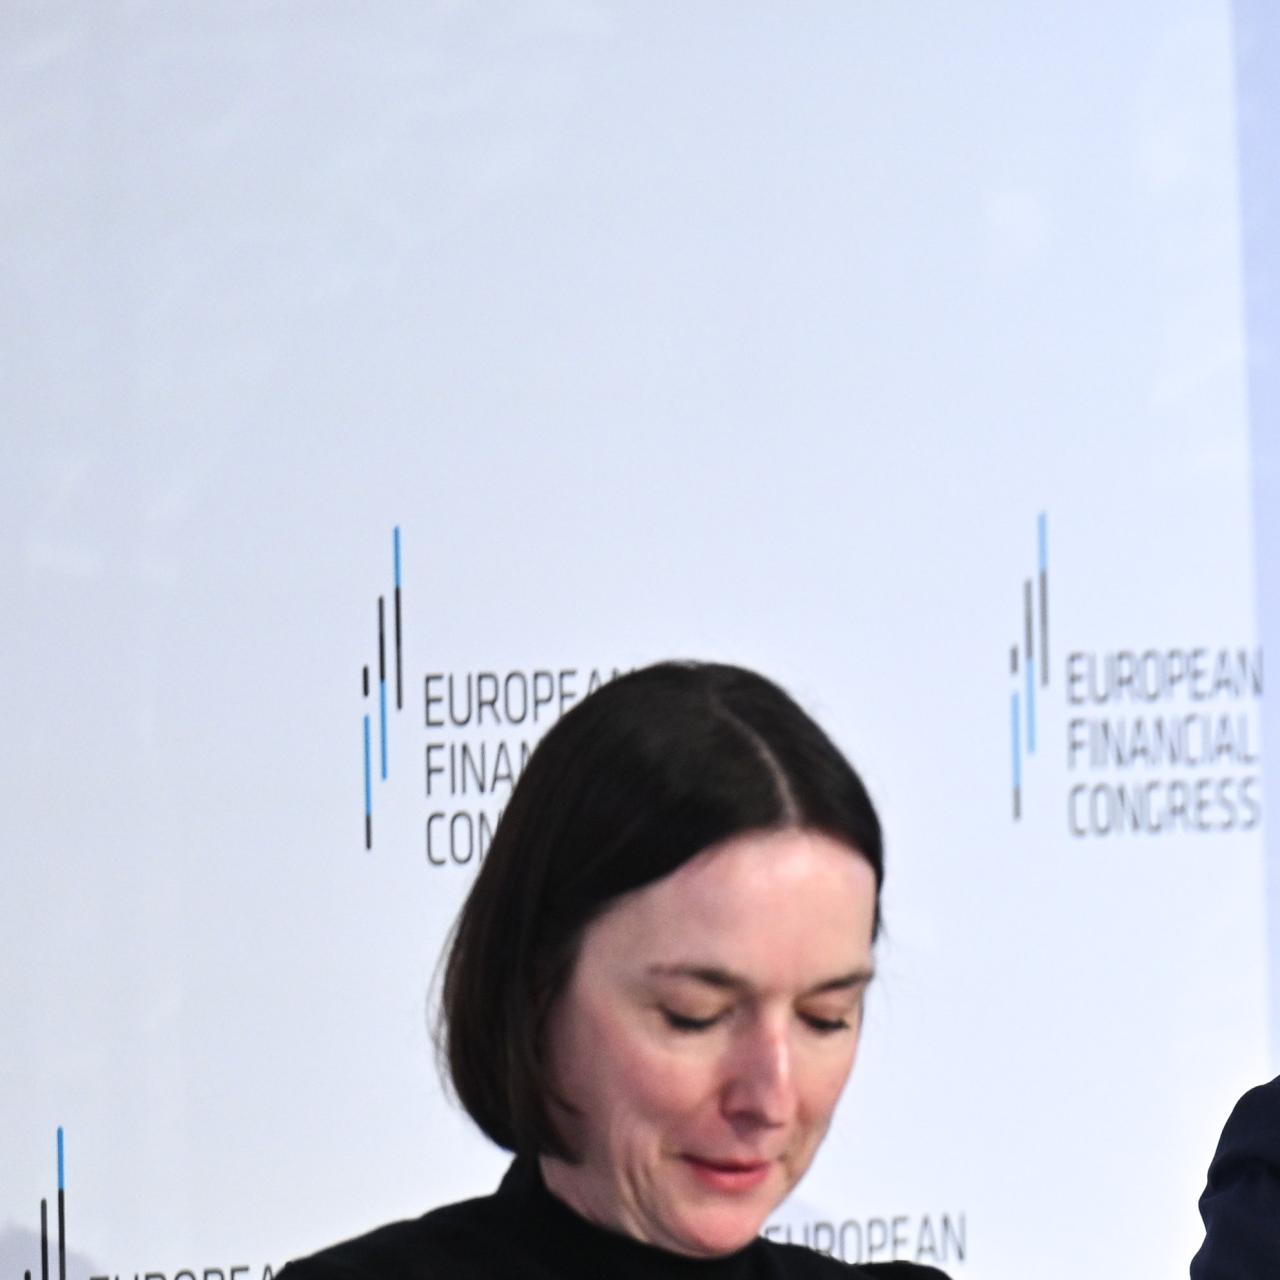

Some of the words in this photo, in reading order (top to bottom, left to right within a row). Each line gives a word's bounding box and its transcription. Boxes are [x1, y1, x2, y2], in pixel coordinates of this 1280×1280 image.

[424, 667, 638, 728] EUROPE
[1066, 645, 1263, 705] EUROPEAN
[1066, 713, 1259, 771] FINANCIAL
[1068, 774, 1261, 840] CONGRESS
